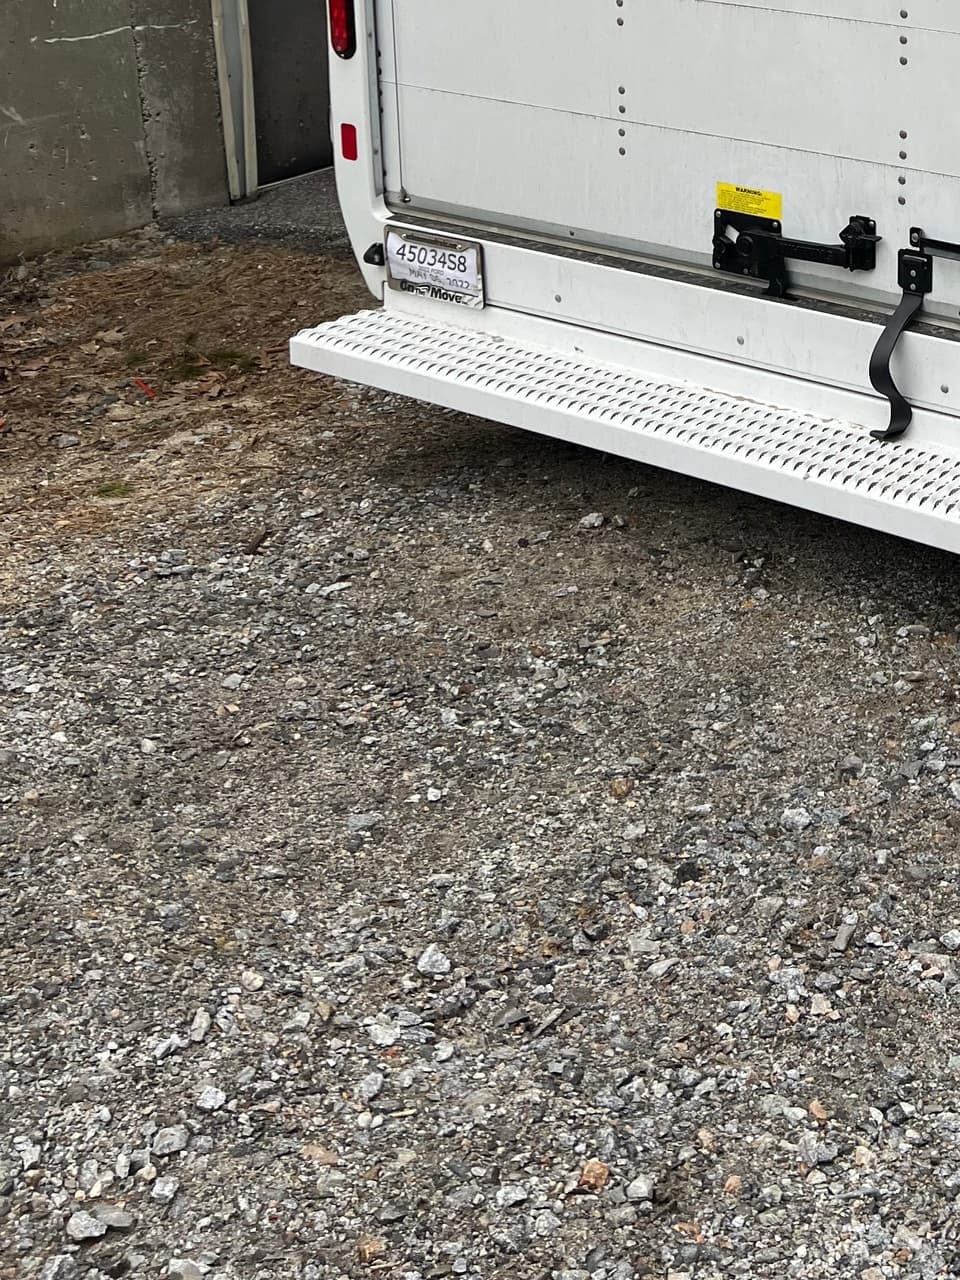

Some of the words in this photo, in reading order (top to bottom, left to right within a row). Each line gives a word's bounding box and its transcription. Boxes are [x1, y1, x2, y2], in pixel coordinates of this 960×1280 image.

[396, 243, 467, 273] 45034S8
[400, 279, 415, 293] On
[430, 286, 462, 304] Move
